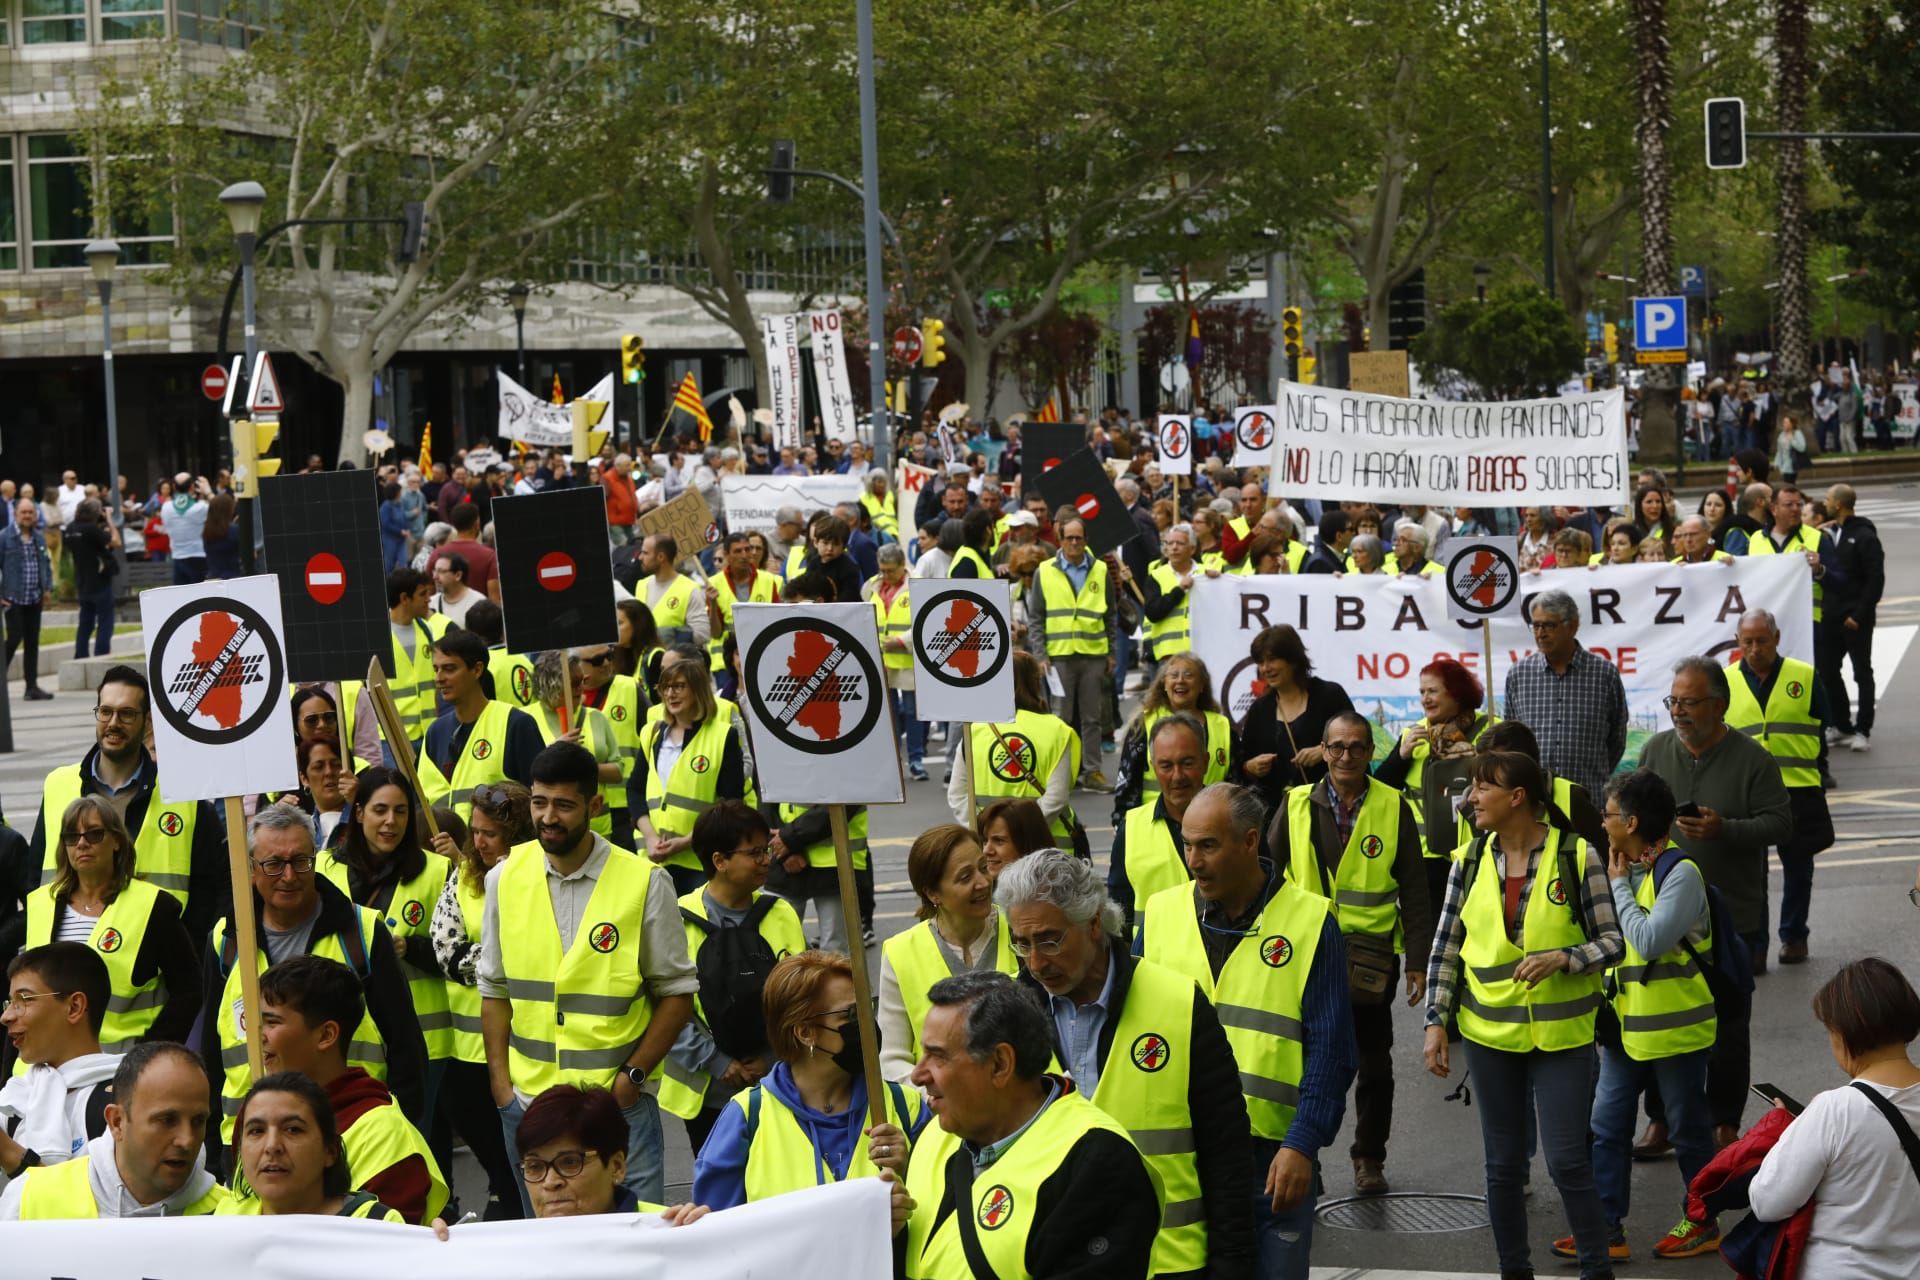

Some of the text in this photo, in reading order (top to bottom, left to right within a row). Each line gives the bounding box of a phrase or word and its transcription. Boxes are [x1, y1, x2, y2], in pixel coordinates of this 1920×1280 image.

[812, 312, 839, 332] NO
[1645, 303, 1676, 344] P
[823, 343, 846, 433] MOLINOS
[1286, 392, 1328, 432] NOS
[1341, 397, 1444, 437] AHOGARON
[1452, 406, 1491, 438] CON
[1501, 400, 1604, 439] PANTANOS
[1318, 450, 1343, 485] LO
[1352, 449, 1421, 488] HARÁN
[1429, 454, 1459, 491] CON
[1467, 455, 1527, 492] PLACAS
[1535, 452, 1621, 491] SOLARES!
[1239, 585, 1748, 631] RIBARZA
[181, 625, 250, 716] RIBAGORZA NO SE VENDE
[778, 647, 846, 724] RIBAGORZA NO SE VENDE
[1356, 652, 1409, 680] NO
